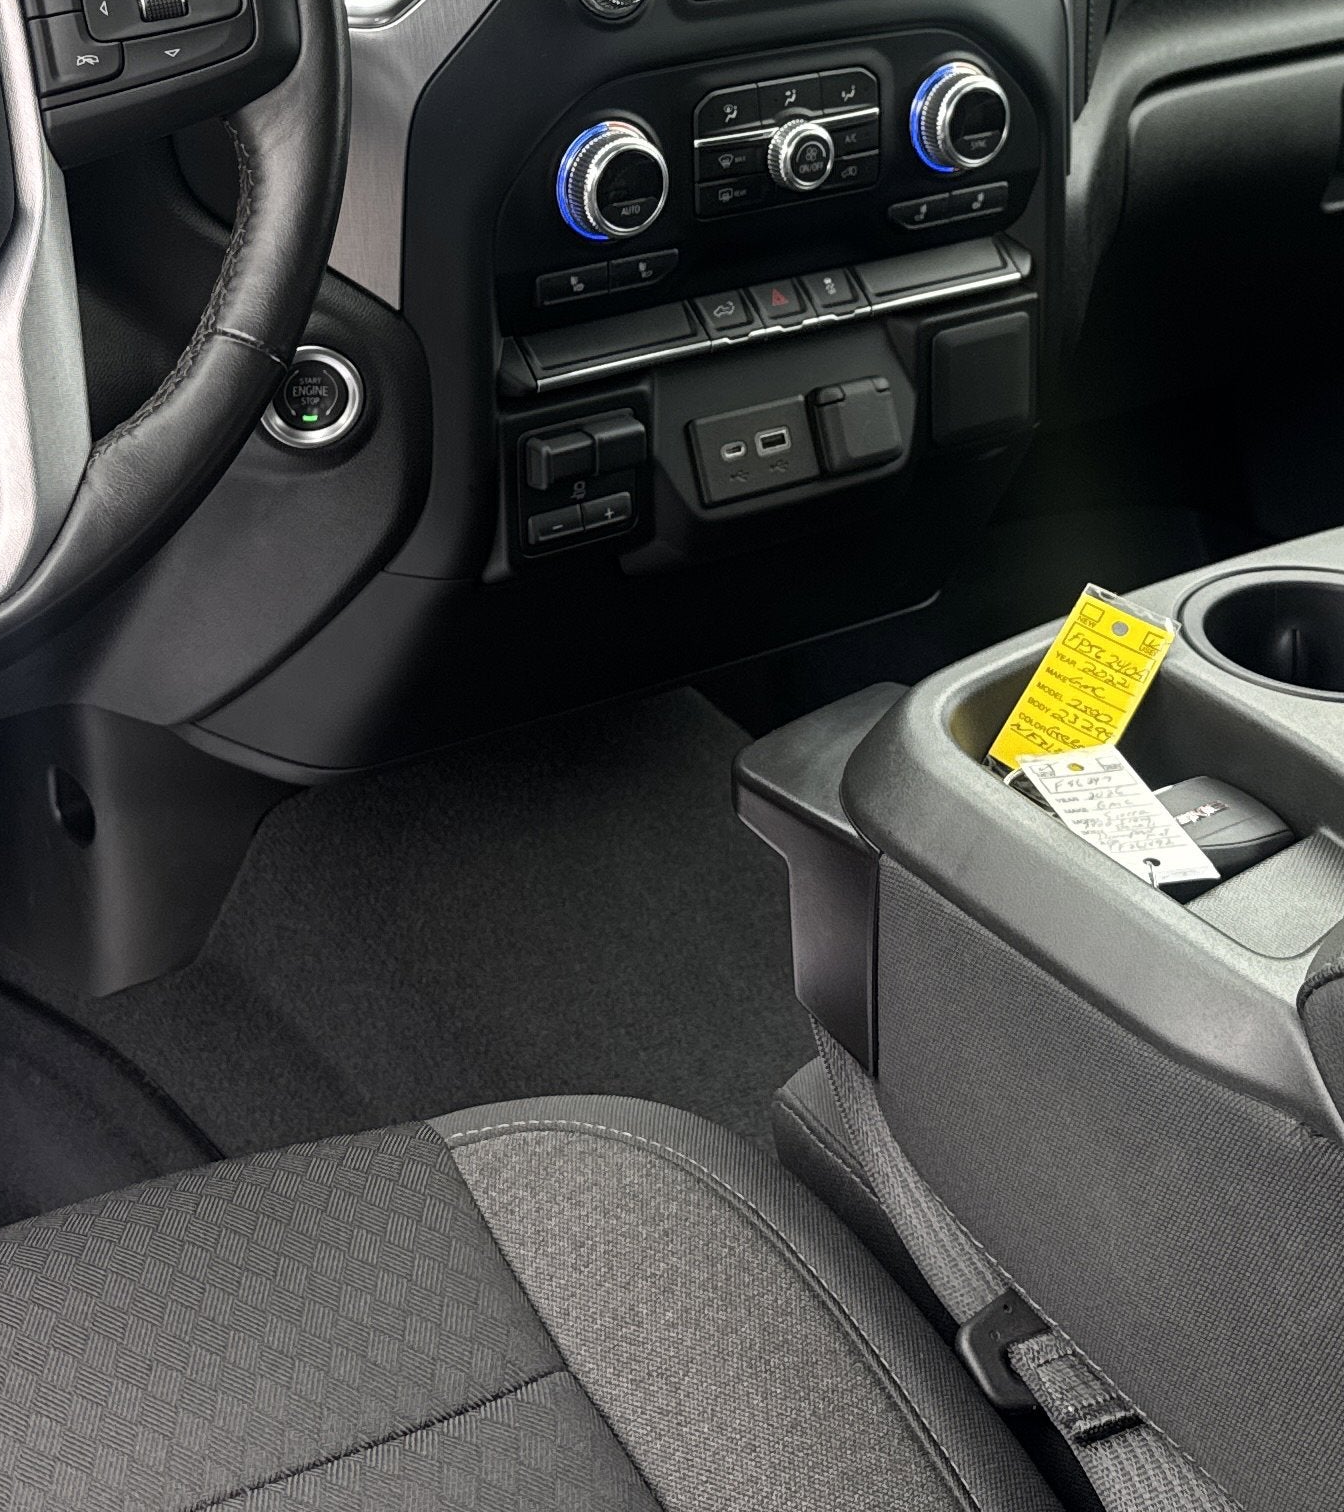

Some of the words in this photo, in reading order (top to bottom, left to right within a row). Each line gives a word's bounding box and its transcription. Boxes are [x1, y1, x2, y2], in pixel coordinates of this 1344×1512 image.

[799, 161, 824, 174] ON/OFF
[292, 386, 328, 397] ENGINE
[1077, 616, 1097, 629] NEW
[1056, 651, 1077, 667] YEAR
[1046, 667, 1068, 683] MAKE
[1036, 682, 1063, 702] MODEL
[1027, 697, 1050, 714] BODY
[1019, 712, 1046, 732] COLOR
